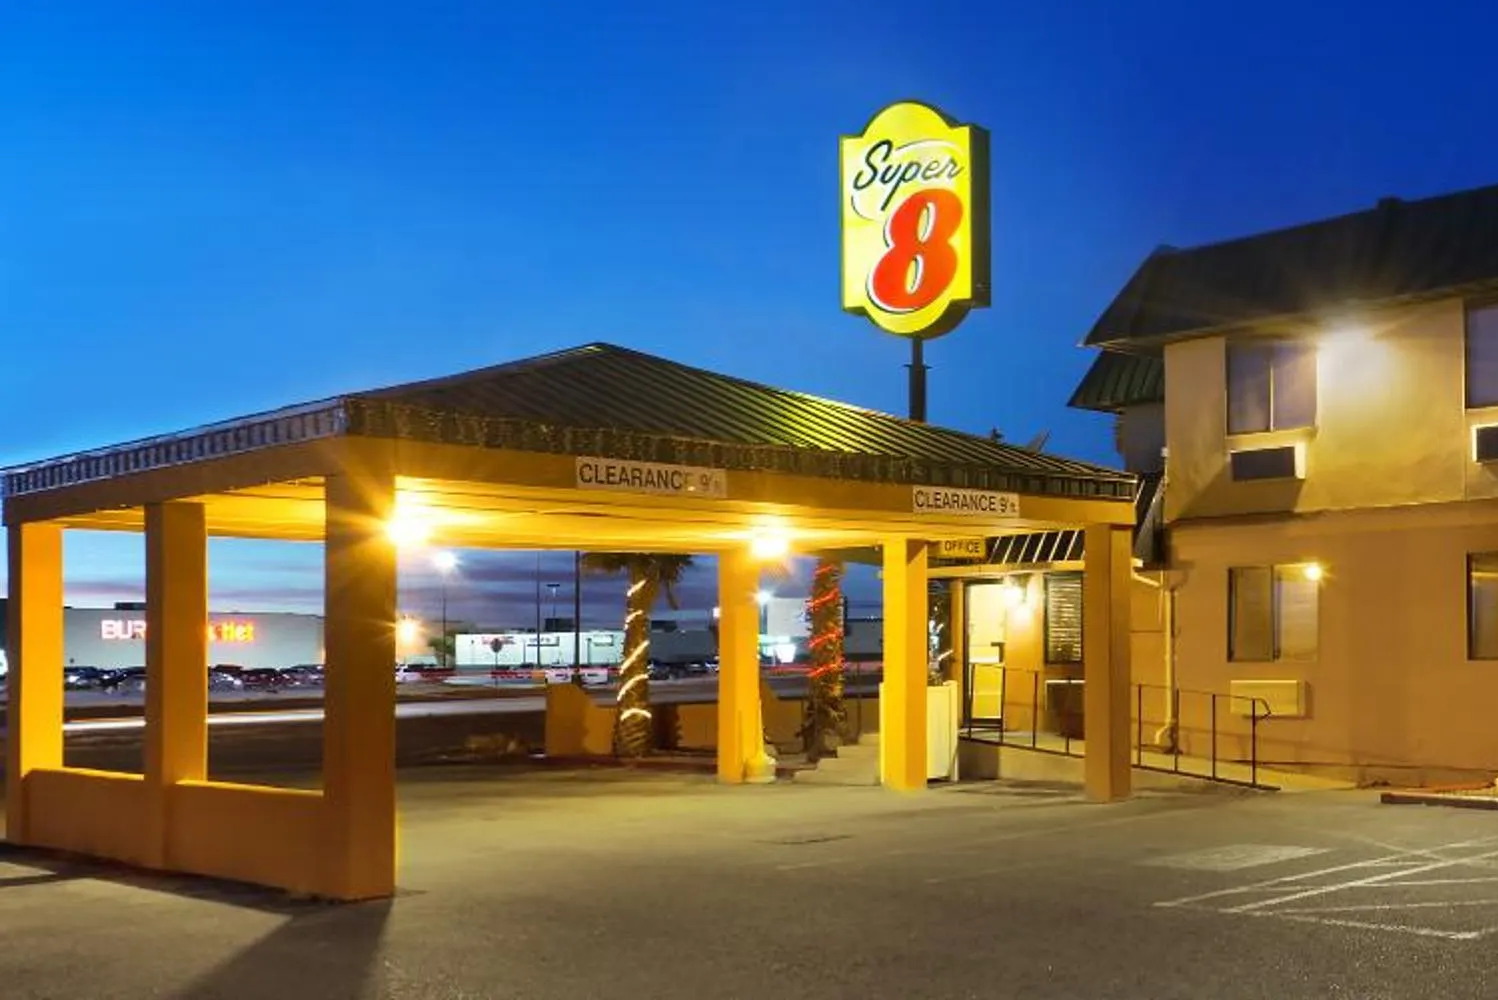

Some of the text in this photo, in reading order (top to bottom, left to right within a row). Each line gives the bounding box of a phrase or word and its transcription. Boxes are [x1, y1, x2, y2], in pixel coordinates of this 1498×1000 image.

[854, 139, 964, 211] Super
[867, 188, 964, 314] 8
[914, 490, 997, 512] CLEARANCE
[944, 540, 981, 553] OFFICE
